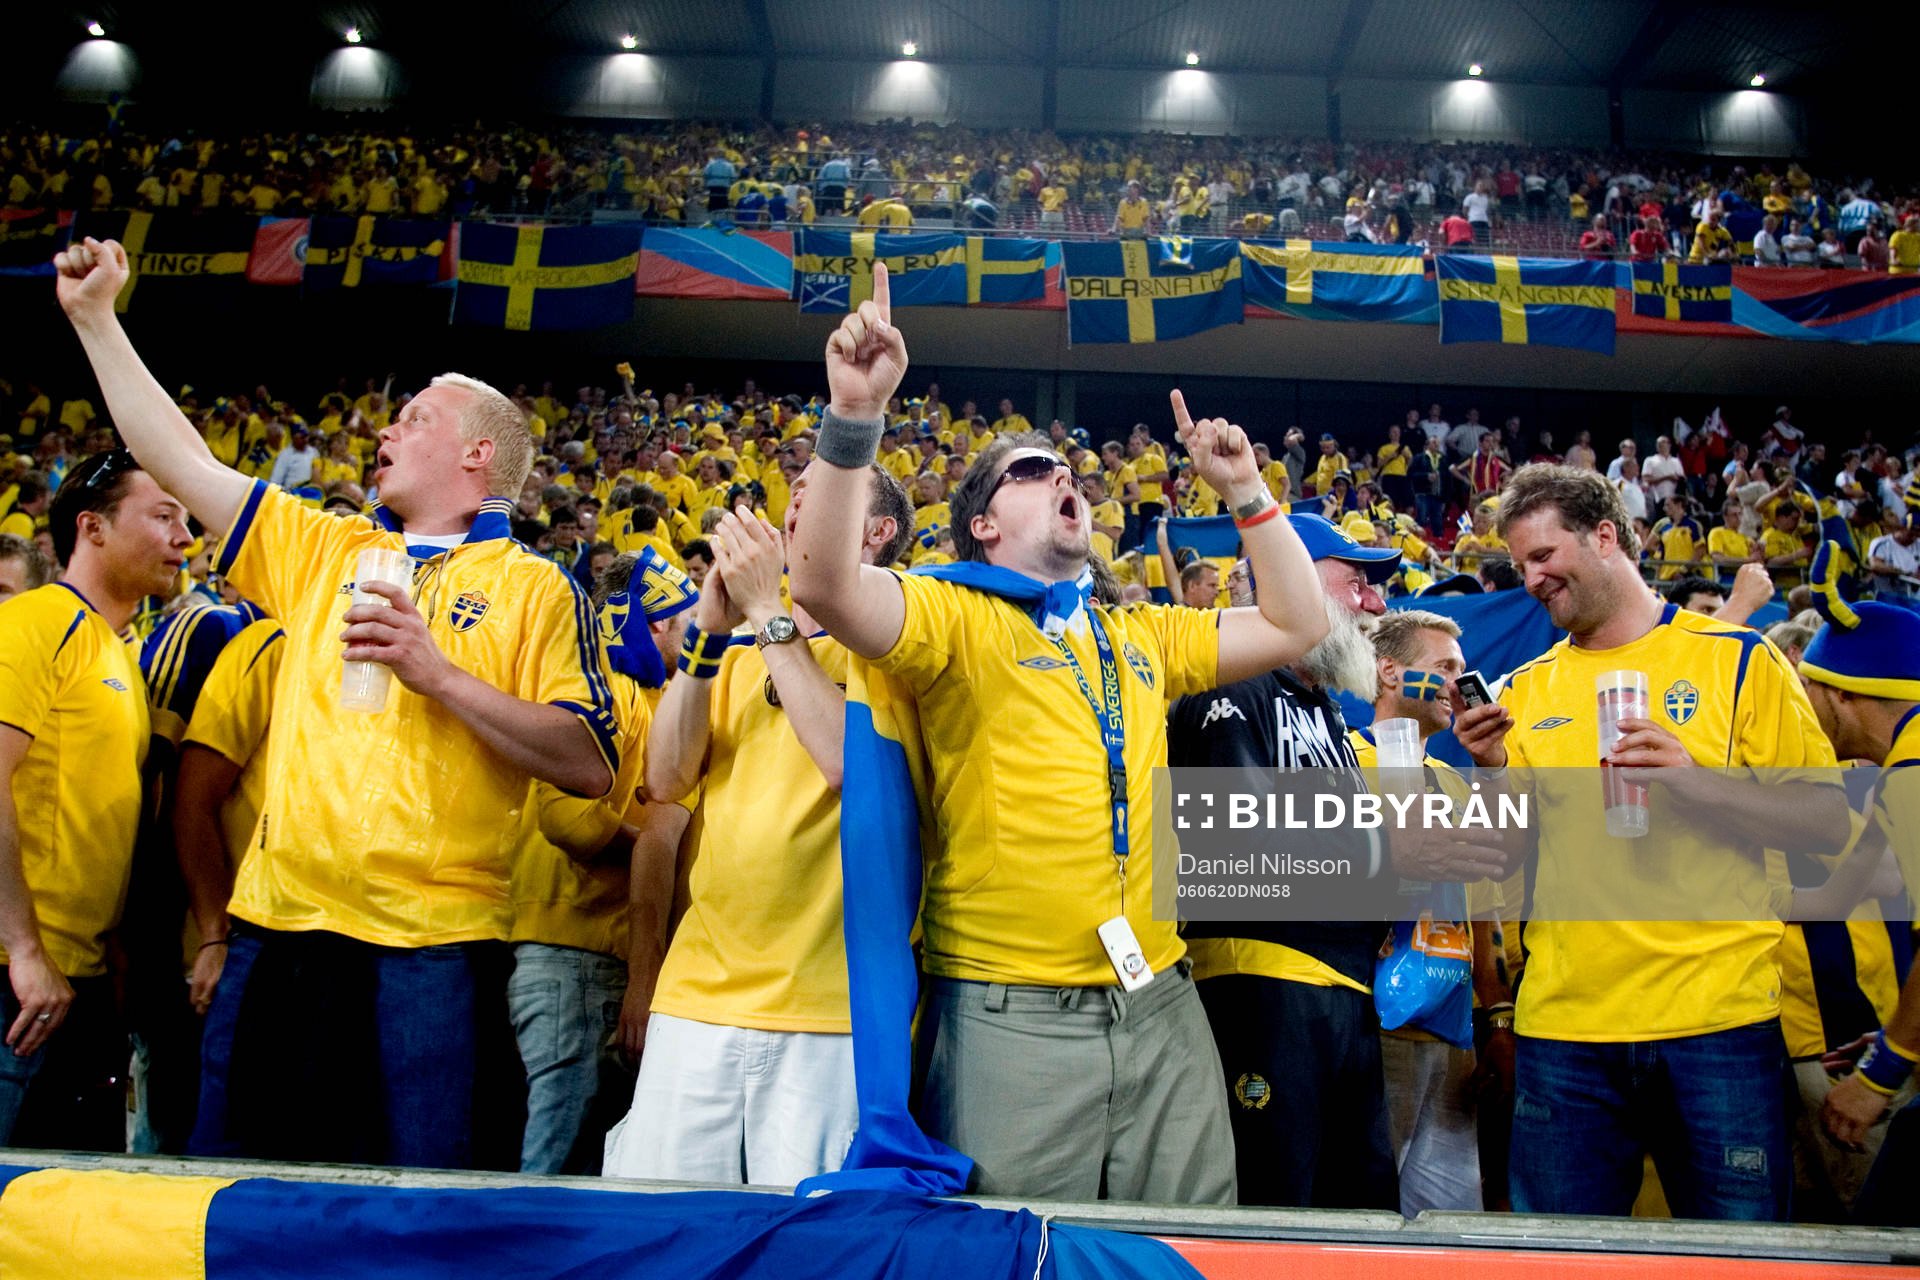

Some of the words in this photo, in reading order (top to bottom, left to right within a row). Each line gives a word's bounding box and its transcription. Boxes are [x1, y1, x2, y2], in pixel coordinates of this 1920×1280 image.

[128, 252, 211, 273] TINGE
[1651, 283, 1716, 301] AVESTA
[1102, 659, 1123, 731] SVERIGE
